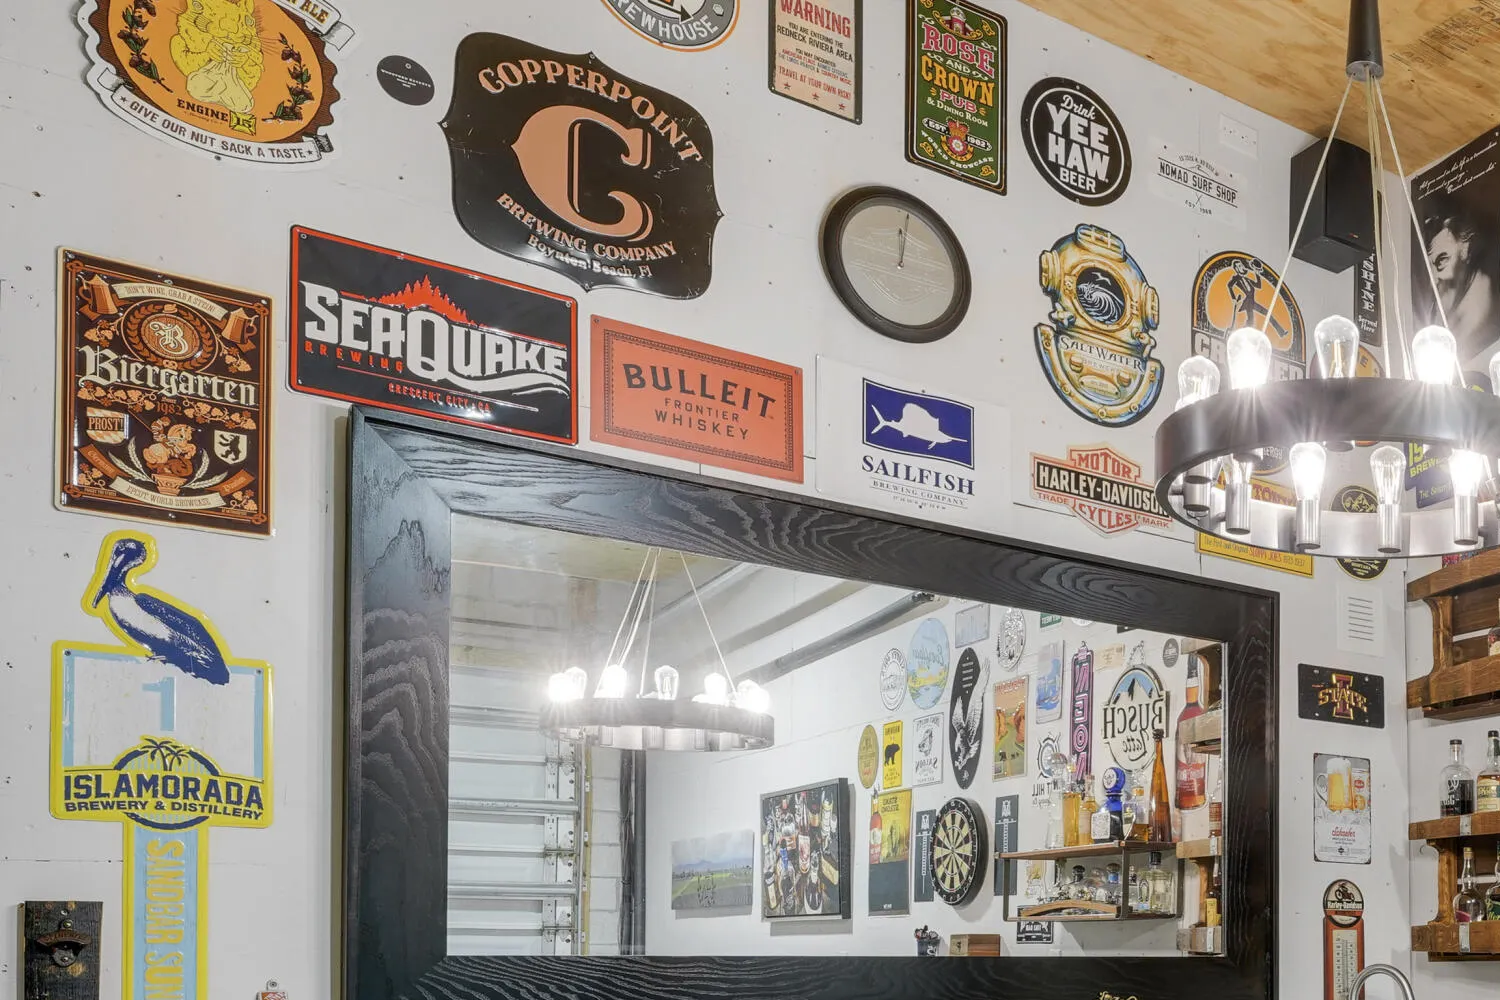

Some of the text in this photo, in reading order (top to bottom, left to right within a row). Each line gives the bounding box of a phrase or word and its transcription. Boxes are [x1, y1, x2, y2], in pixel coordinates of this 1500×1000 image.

[780, 0, 851, 38] WARNING
[777, 25, 853, 62] REDNECK RIVIERA AREA
[921, 23, 995, 79] ROSE
[920, 55, 995, 107] CROWN
[943, 60, 972, 78] AND
[177, 98, 229, 123] ENGINE
[477, 58, 704, 164] COPPERPOINT
[940, 89, 978, 114] PUB
[1060, 94, 1097, 120] Drink
[129, 100, 306, 160] GIVE OUR NUT SACK A TASTE
[1046, 101, 1109, 154] YEE
[1048, 132, 1110, 183] HAW
[1059, 167, 1097, 193] BEER
[1160, 161, 1189, 184] NOMAD
[1192, 174, 1213, 193] SURF
[1216, 185, 1237, 203] SHOP
[496, 193, 678, 262] BREWING COMPANY
[304, 340, 405, 373] BREWING
[78, 345, 257, 406] Biergarten
[622, 363, 777, 418] BULLEIT
[88, 416, 125, 431] PROST!
[654, 408, 750, 441] WHISKEY
[664, 397, 740, 422] FRONTIER
[861, 454, 976, 497] SAILFISH
[1077, 450, 1134, 480] MOTOR
[872, 480, 918, 496] BREWING
[920, 490, 965, 506] COMPANY
[1037, 492, 1069, 504] TRADE
[1078, 502, 1134, 530] CYCLES
[1141, 517, 1170, 529] MARK
[63, 773, 265, 811] ISLAMORADA
[64, 799, 264, 821] BREWERY & DISTILLERY
[144, 838, 186, 947] SANDBAR
